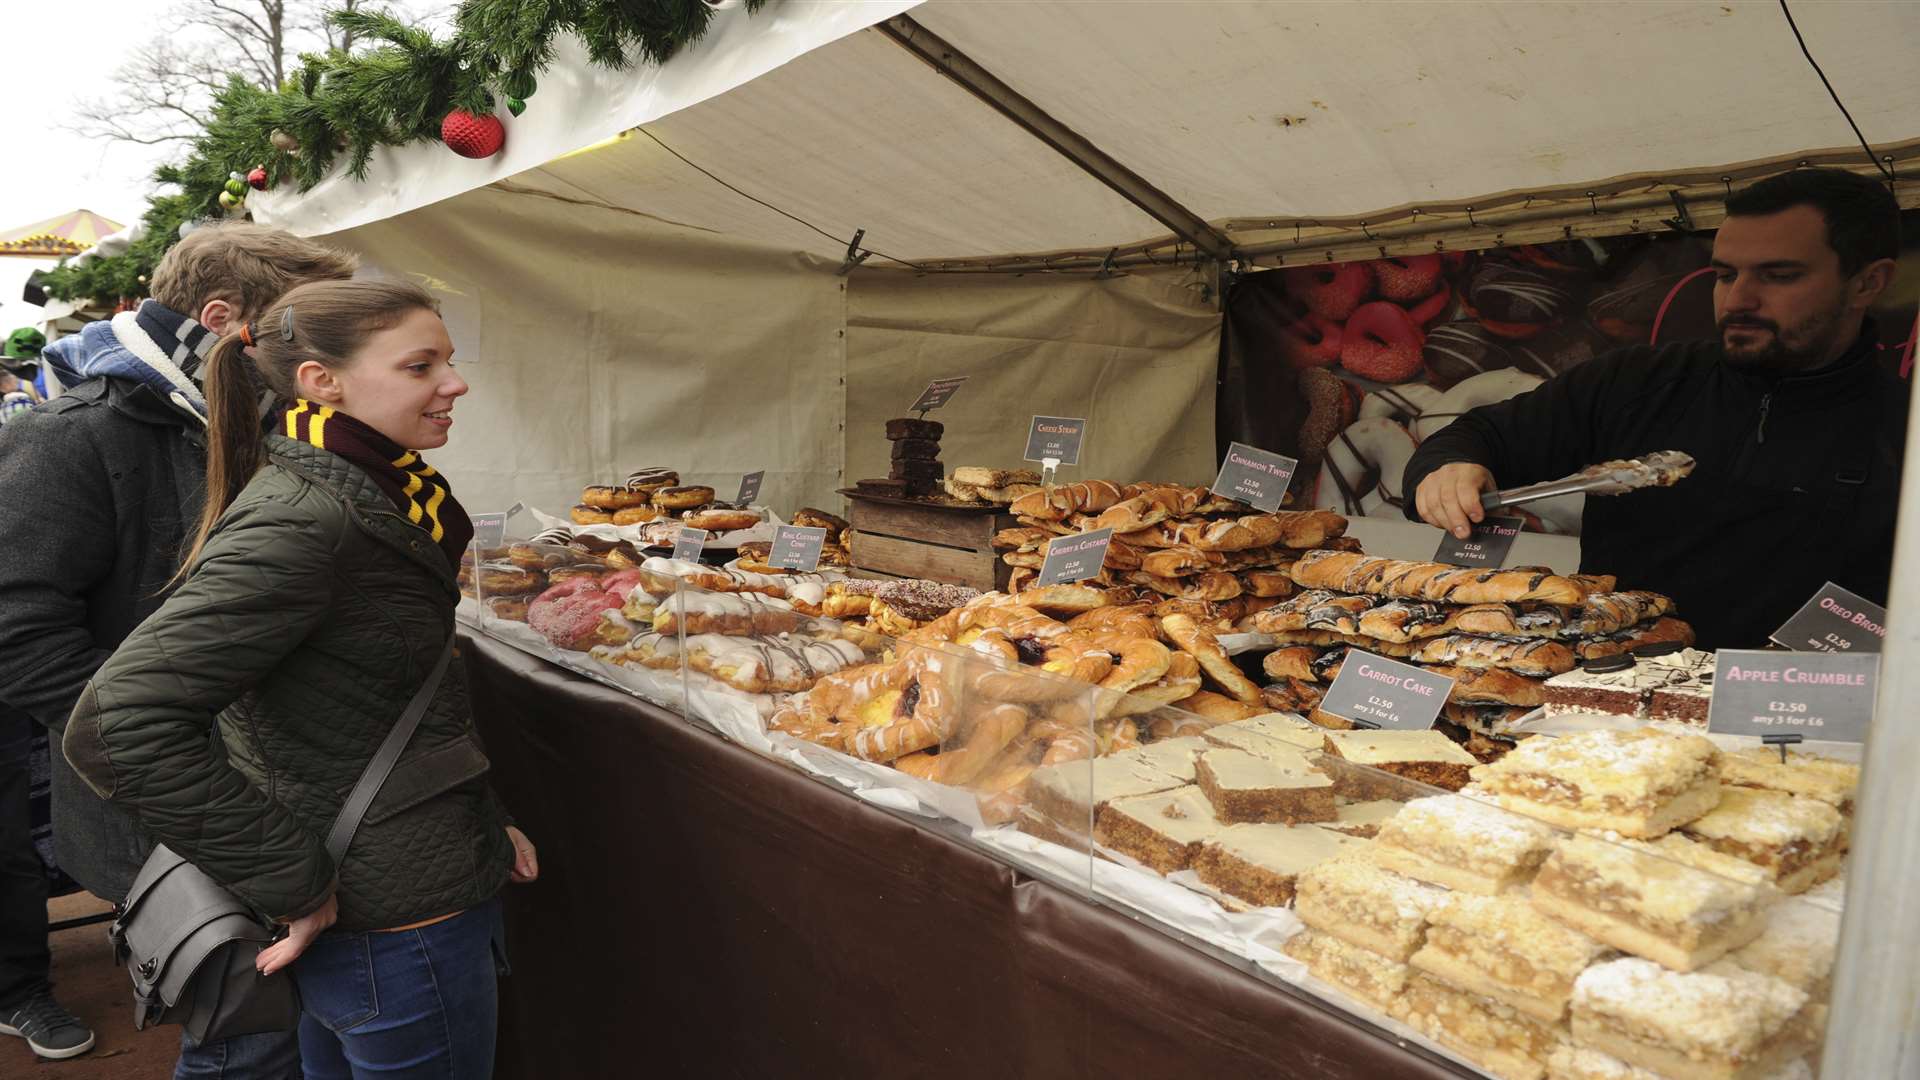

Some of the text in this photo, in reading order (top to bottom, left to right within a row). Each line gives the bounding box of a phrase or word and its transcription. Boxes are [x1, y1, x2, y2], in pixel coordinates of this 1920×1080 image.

[1230, 453, 1290, 479] CINNAMON TWIST
[1243, 478, 1260, 489] £2.50
[1493, 525, 1519, 536] TWIST
[1050, 545, 1073, 556] CHERRY
[1080, 538, 1108, 550] CUSTARD
[1464, 543, 1482, 551] £2.50
[1820, 597, 1852, 619] OREO
[1825, 633, 1851, 649] £2.50
[1358, 664, 1434, 697] CARROT CAKE
[1725, 665, 1865, 686] APPLE CRUMBLE
[1368, 695, 1393, 709] £2.50
[1768, 701, 1807, 713] £2.50
[1353, 703, 1367, 713] any
[1375, 708, 1388, 718] for
[1388, 713, 1399, 722] £6
[1752, 715, 1774, 725] any
[1786, 716, 1805, 725] for
[1807, 717, 1824, 726] £6
